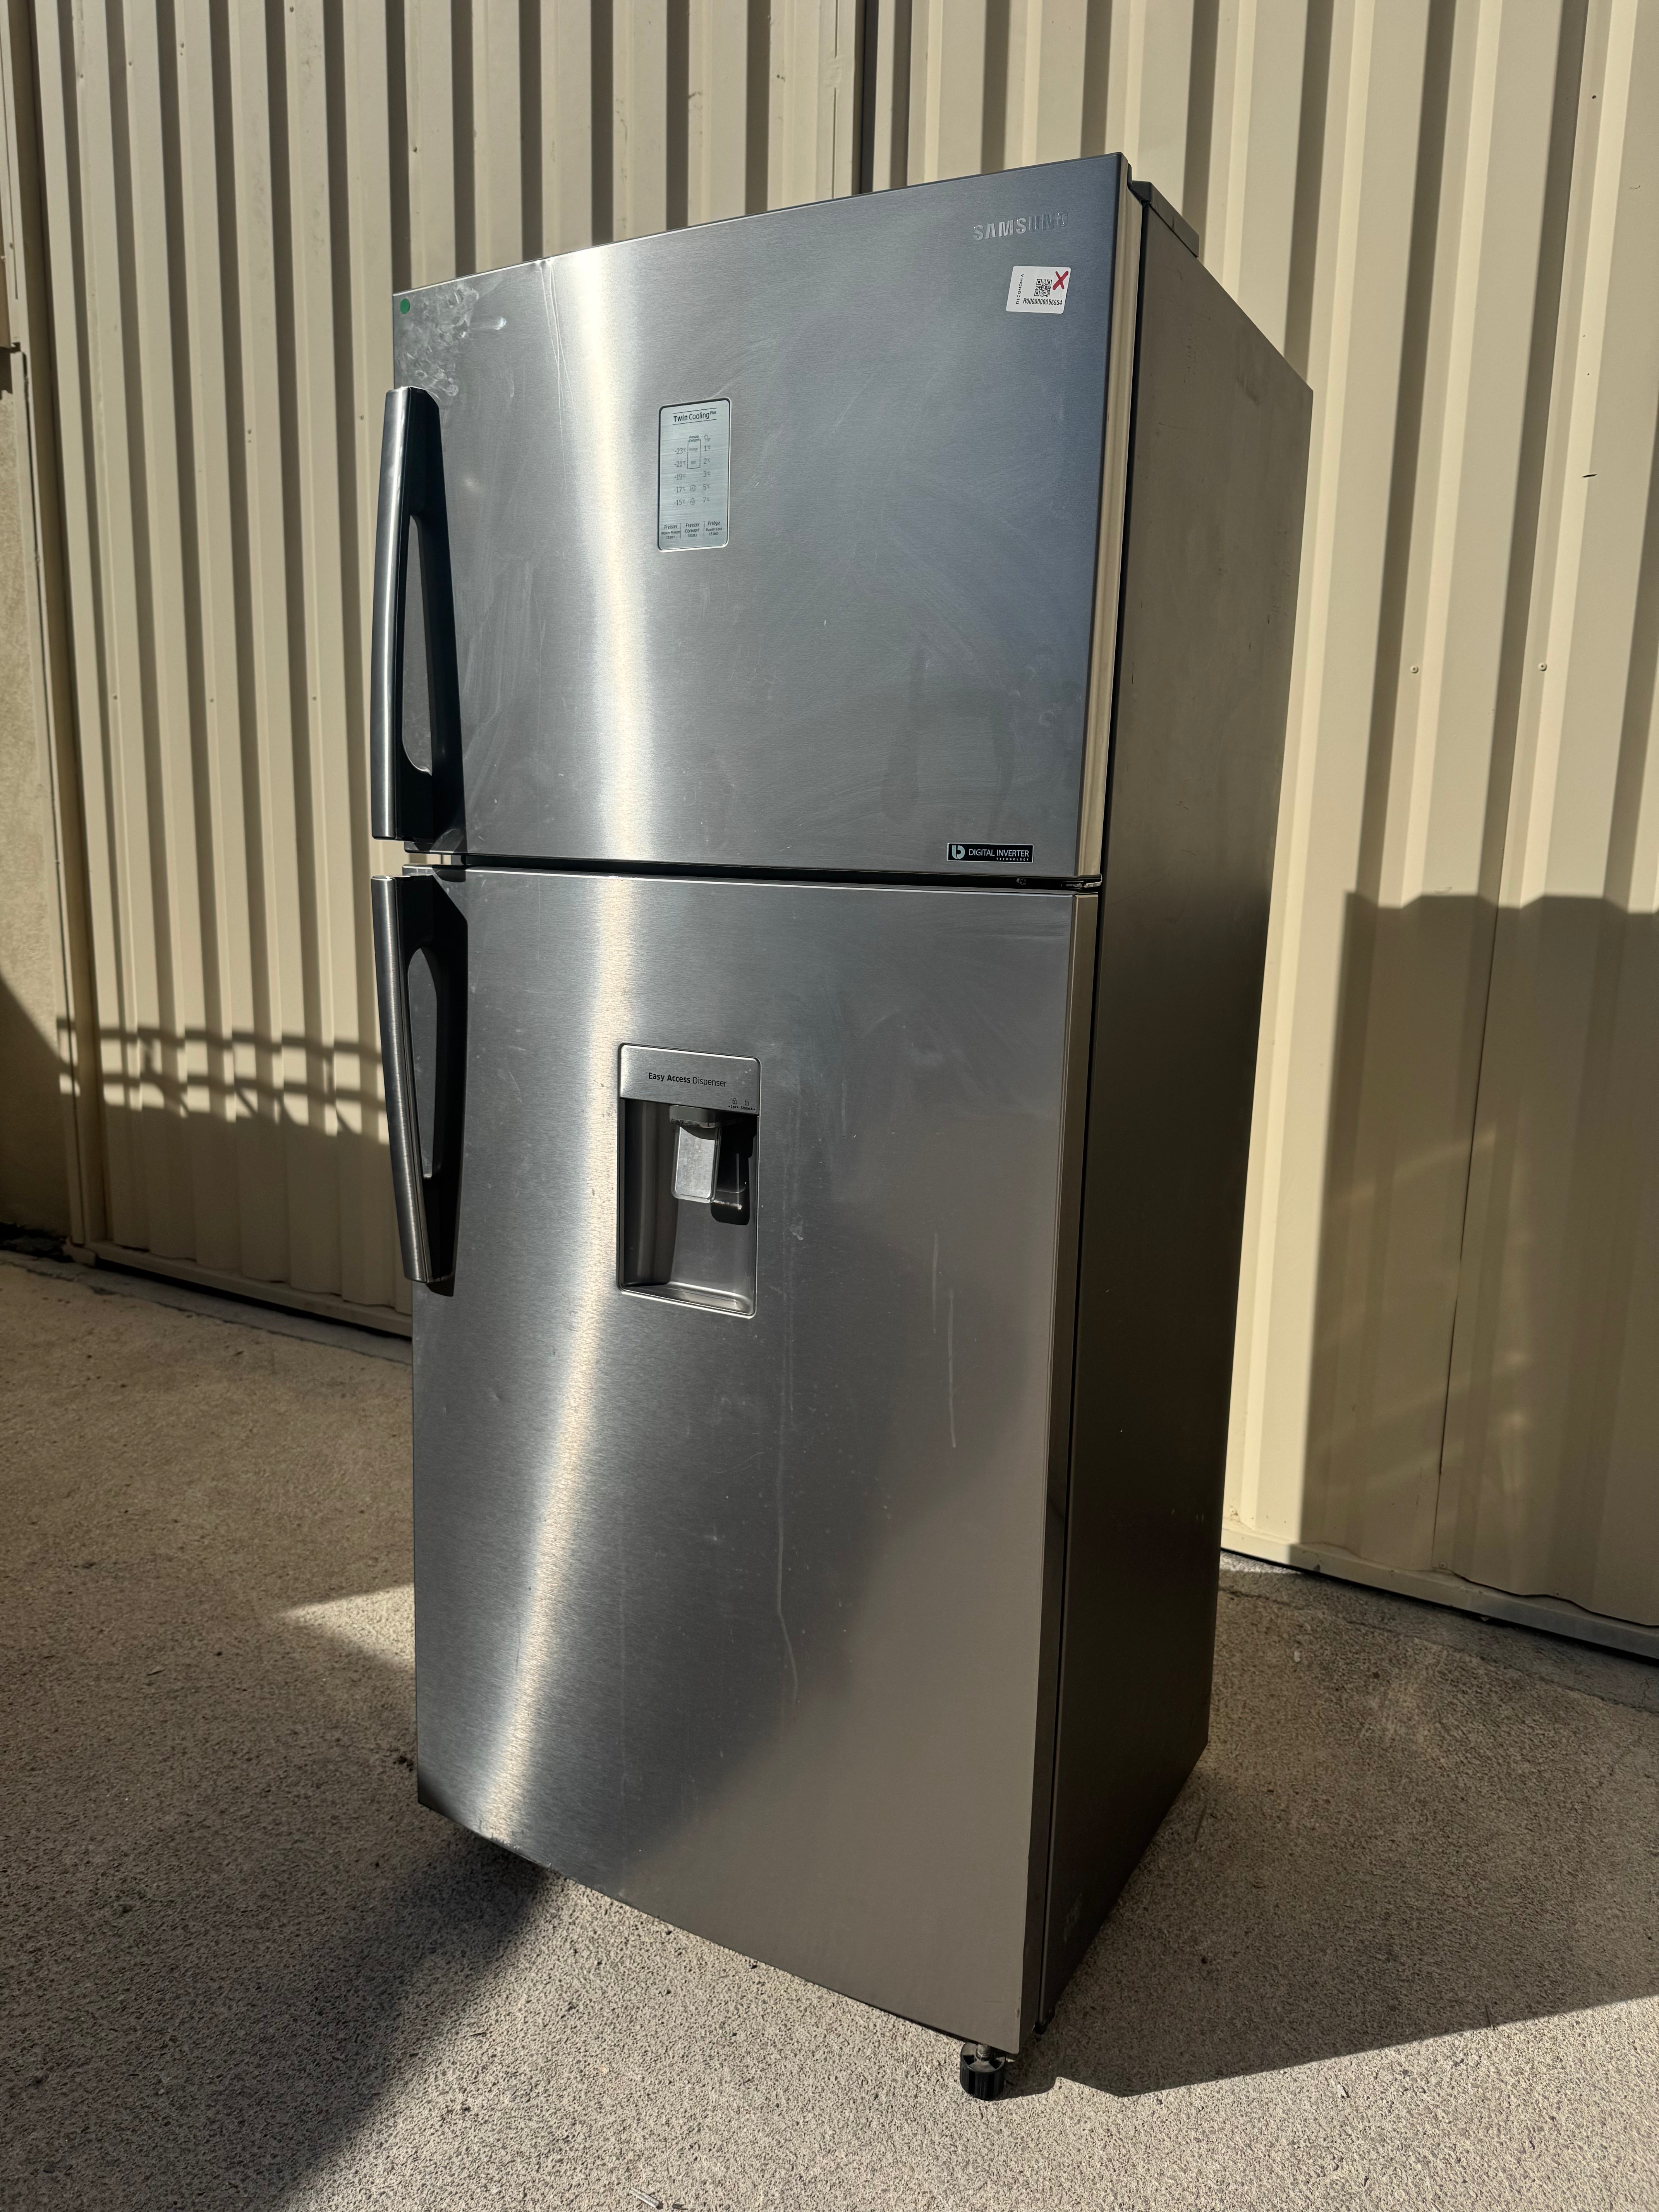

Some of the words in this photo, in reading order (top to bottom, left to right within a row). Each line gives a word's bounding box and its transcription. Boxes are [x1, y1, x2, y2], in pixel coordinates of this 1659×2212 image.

[973, 211, 1068, 240] SAMSUNG
[648, 1072, 665, 1082] Easy
[667, 1074, 690, 1083] Access
[693, 1077, 727, 1087] Dispenser
